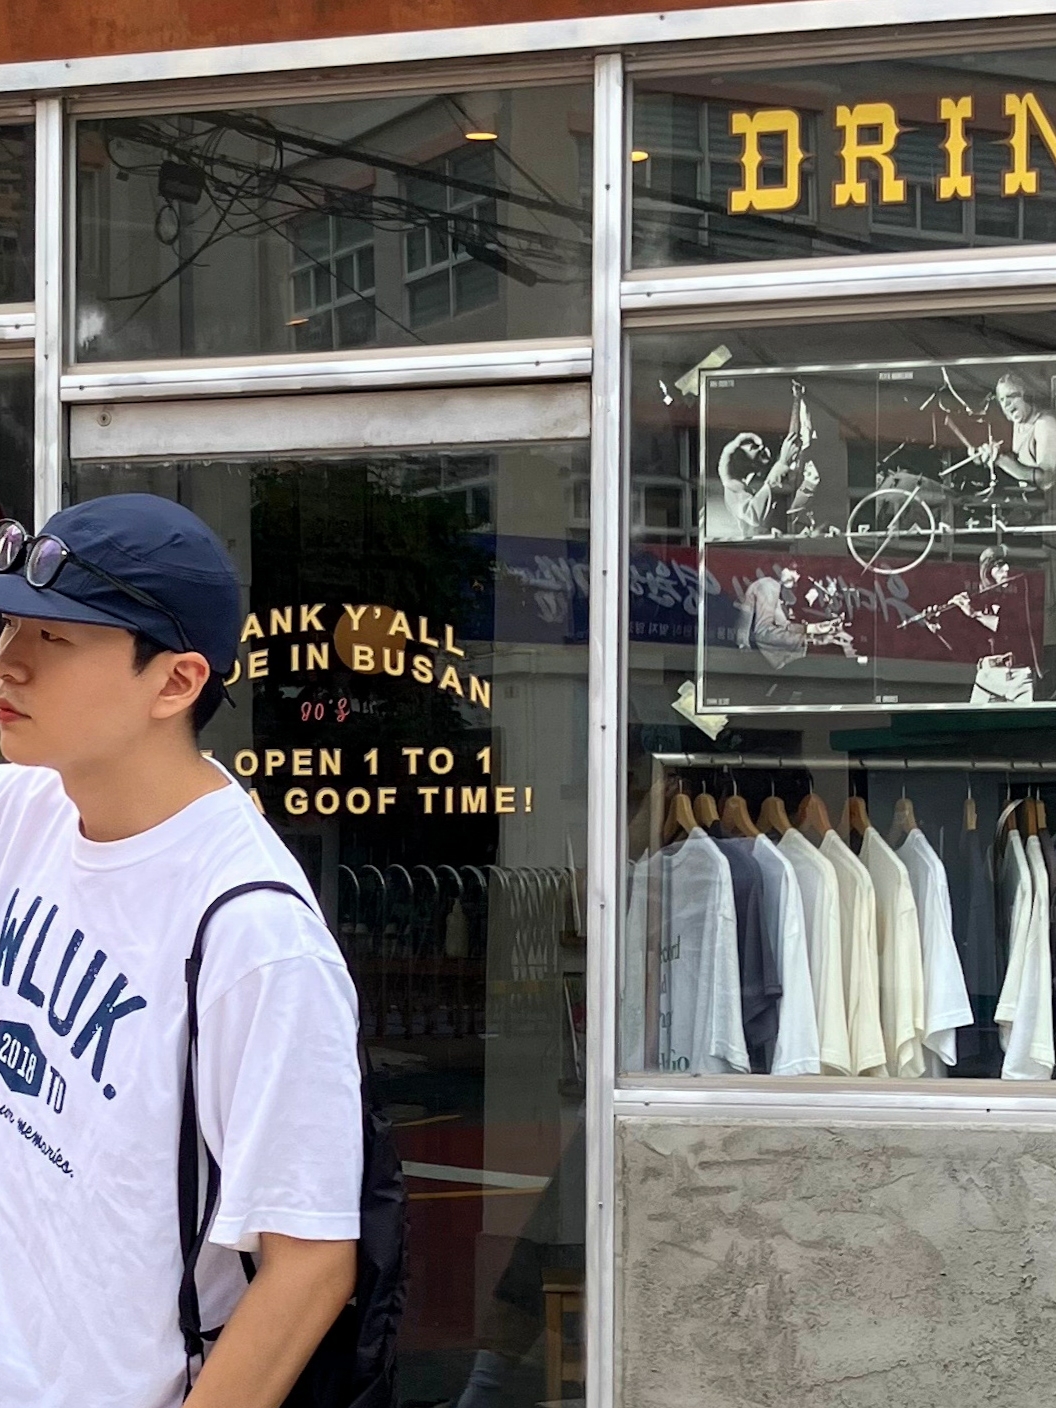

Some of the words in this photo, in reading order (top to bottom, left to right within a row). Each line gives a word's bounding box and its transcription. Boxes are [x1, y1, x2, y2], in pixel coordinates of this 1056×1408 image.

[728, 92, 1056, 216] DRIN
[240, 603, 326, 643] ANK
[343, 603, 466, 657] Y'ALL
[290, 642, 329, 671] IN
[352, 643, 492, 709] BUSAN
[234, 748, 342, 776] OPEN
[364, 747, 379, 775] 1
[401, 746, 454, 775] TO
[476, 746, 491, 774] 1
[284, 786, 397, 815] GOOF
[417, 786, 533, 814] TIME!
[17, 1117, 75, 1179] memories.
